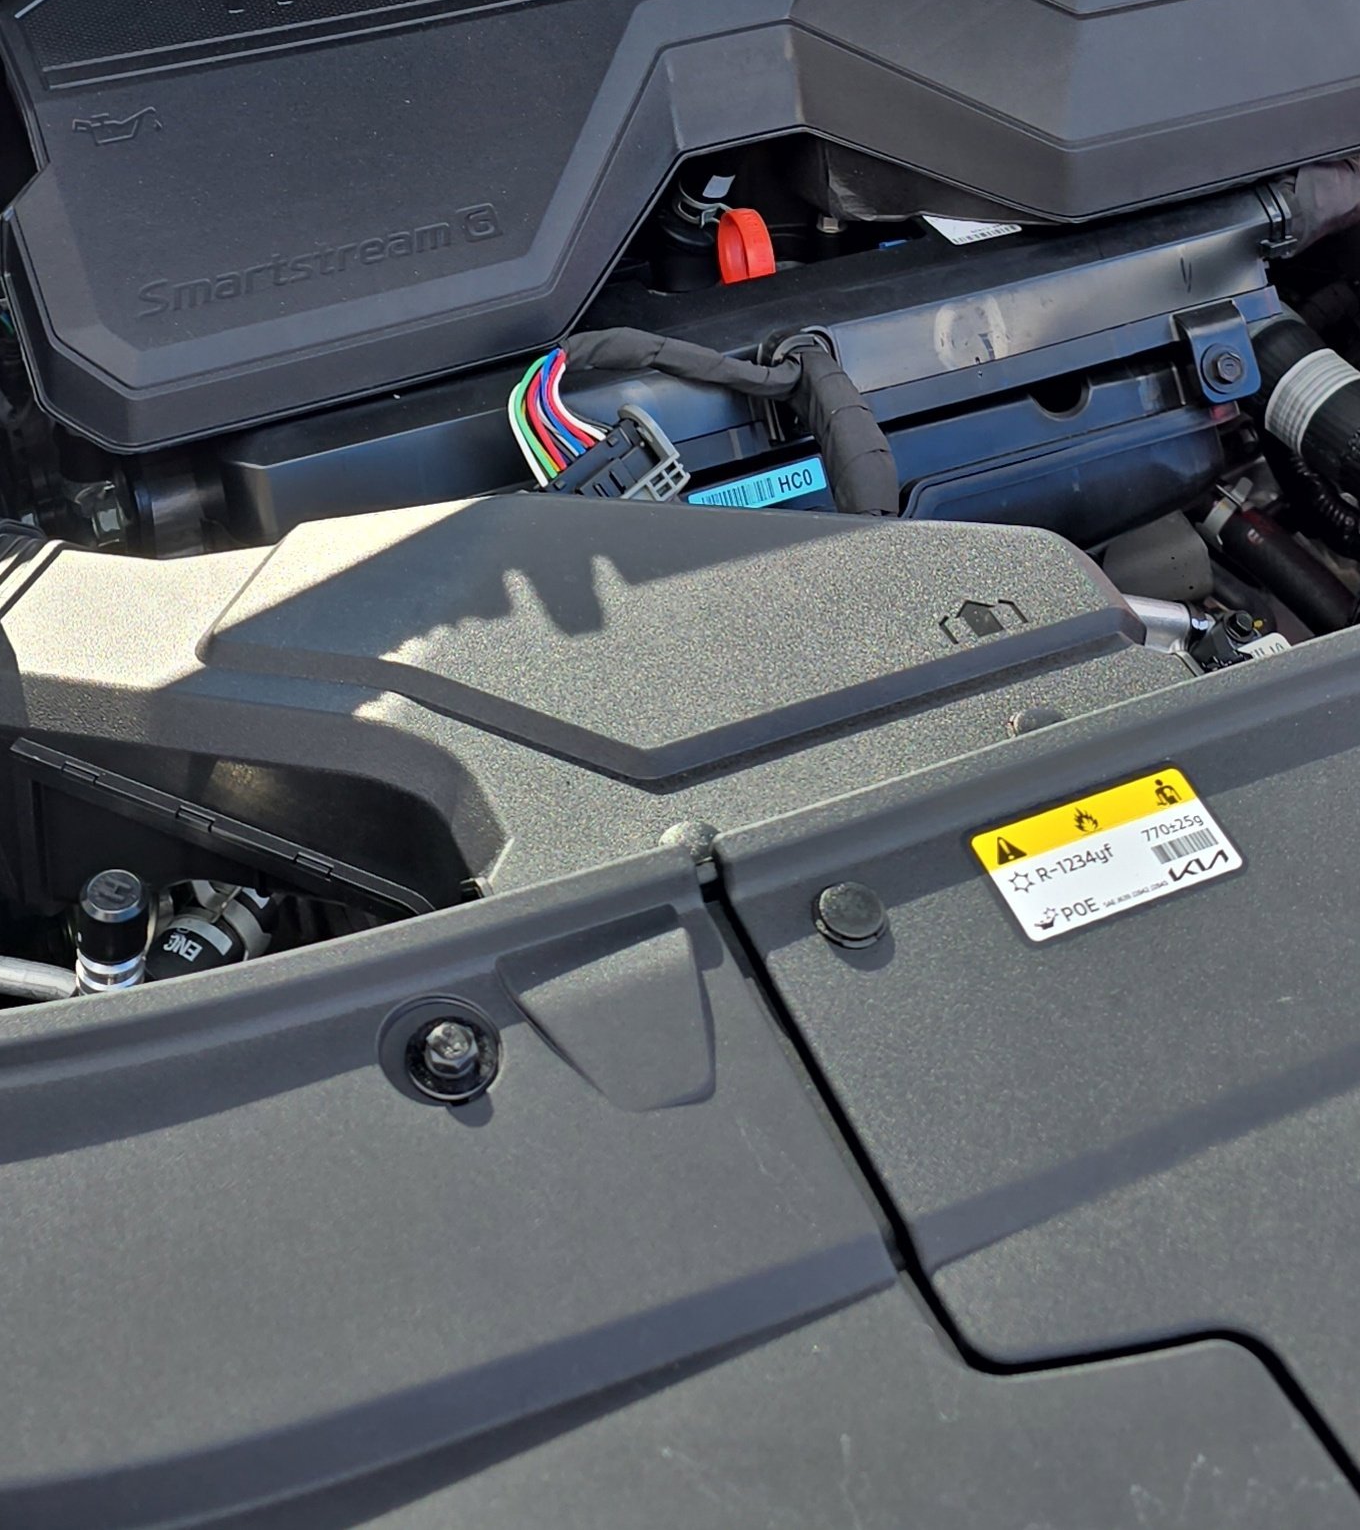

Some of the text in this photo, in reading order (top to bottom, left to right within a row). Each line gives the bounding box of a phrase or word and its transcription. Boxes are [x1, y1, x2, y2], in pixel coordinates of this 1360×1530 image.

[137, 222, 451, 318] Smartstream
[1141, 814, 1204, 842] 770±25g
[1035, 843, 1115, 882] R-1234yf
[1060, 897, 1100, 921] POE
[163, 931, 203, 963] ENG
